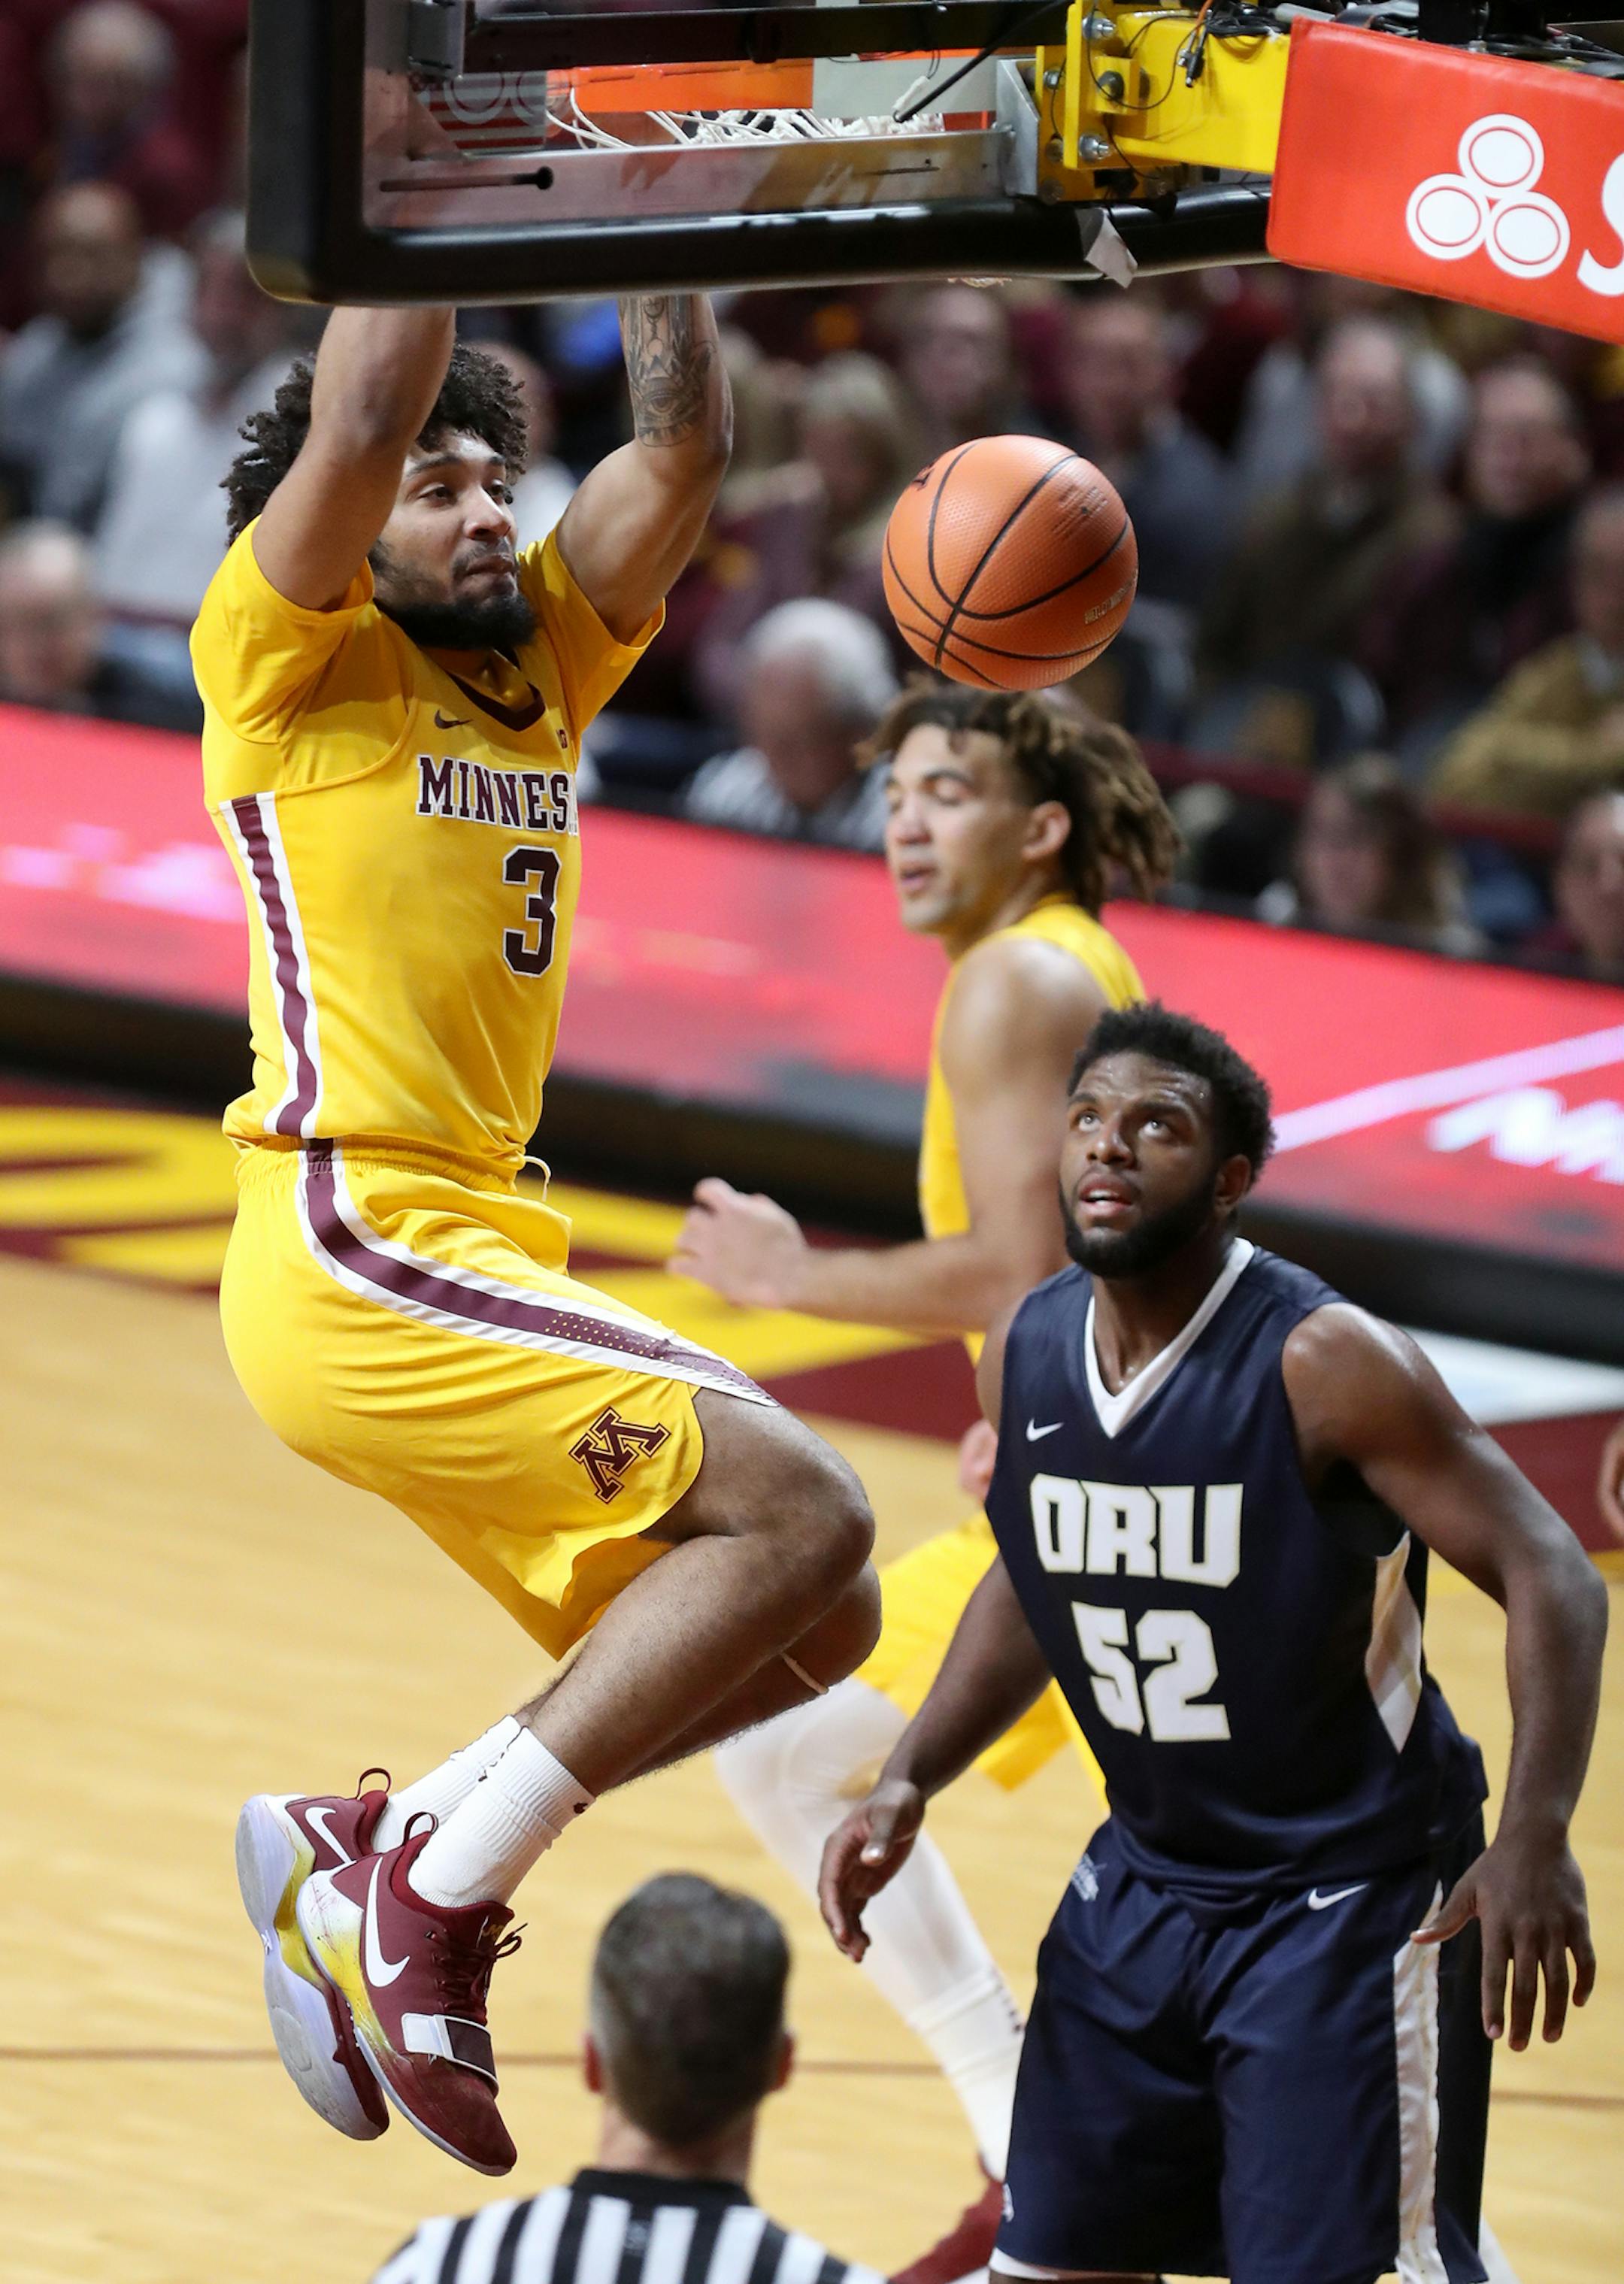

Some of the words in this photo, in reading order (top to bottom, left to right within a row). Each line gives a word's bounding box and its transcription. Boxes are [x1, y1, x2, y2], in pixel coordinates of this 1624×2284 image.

[417, 754, 578, 836] MINNES
[502, 844, 562, 978] 3
[1030, 1473, 1244, 1589] ORU
[1071, 1601, 1232, 1742] 52
